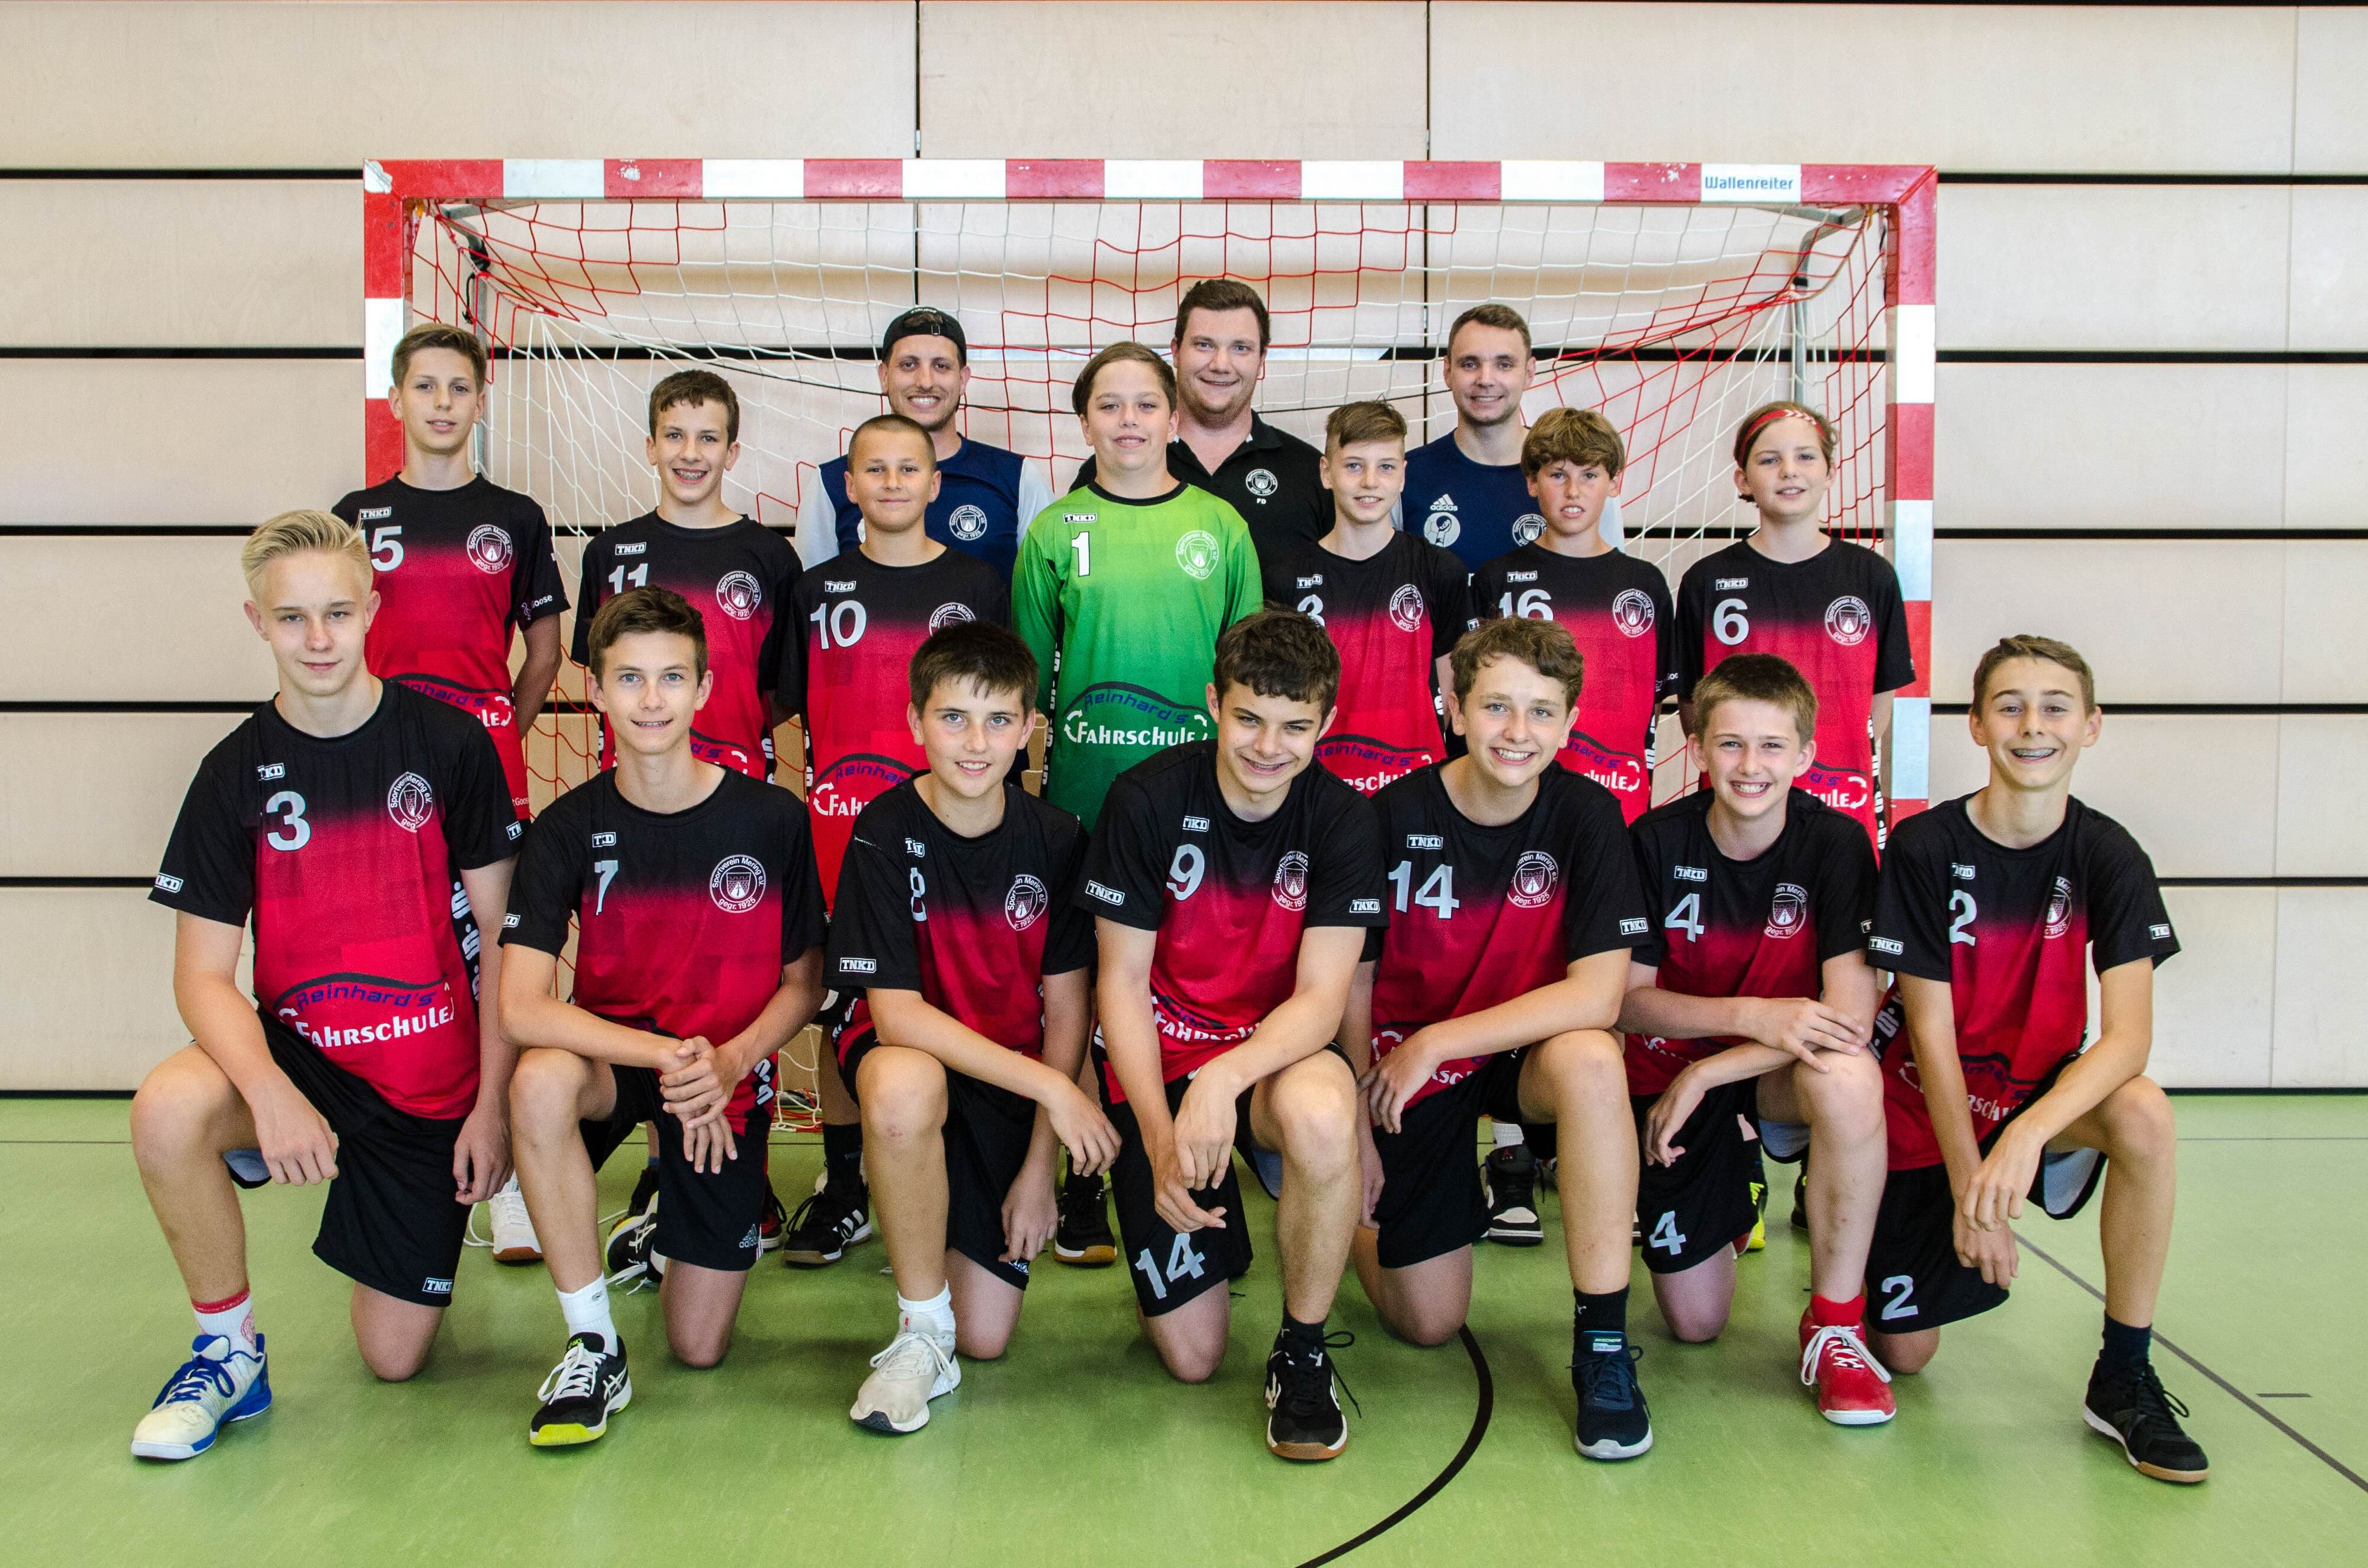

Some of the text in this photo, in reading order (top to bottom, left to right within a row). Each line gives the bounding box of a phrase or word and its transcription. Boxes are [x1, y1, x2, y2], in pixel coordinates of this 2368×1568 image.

[1705, 176, 1794, 190] Wallenreiter
[360, 510, 390, 519] TNKD
[1065, 513, 1096, 521] TNKD
[361, 526, 404, 572] 5
[617, 545, 644, 553] TNKD
[1071, 531, 1090, 577] 1
[609, 563, 648, 594] 11
[826, 582, 855, 591] TNKD
[931, 606, 956, 628] Sportverein
[1498, 589, 1554, 621] 16
[810, 600, 867, 649] 10
[1713, 598, 1749, 645] 6
[1084, 689, 1189, 724] Reinhard's
[266, 791, 311, 852] 3
[1408, 836, 1442, 848] TNKD
[712, 858, 740, 888] Sportverein
[741, 857, 761, 876] Mering
[1166, 843, 1206, 901] 9
[1535, 854, 1555, 870] Mering
[1677, 868, 1706, 880] TNKD
[595, 860, 619, 916] 7
[1024, 877, 1042, 893] Mering
[1089, 882, 1123, 904] TNKD
[1388, 860, 1459, 920] 14
[1513, 893, 1551, 905] gegr. 1925
[718, 898, 756, 910] gegr. 1925
[1353, 900, 1379, 911] TNKD
[1664, 892, 1705, 943] 4
[1950, 889, 1977, 946] 2
[1621, 920, 1647, 932] TNKD
[1870, 938, 1902, 953] TNKD
[842, 959, 875, 972] TNKD
[296, 983, 437, 1012] Reinhard's
[1649, 1210, 1686, 1255] 4
[1135, 1232, 1206, 1300] 14
[1881, 1274, 1918, 1321] 2
